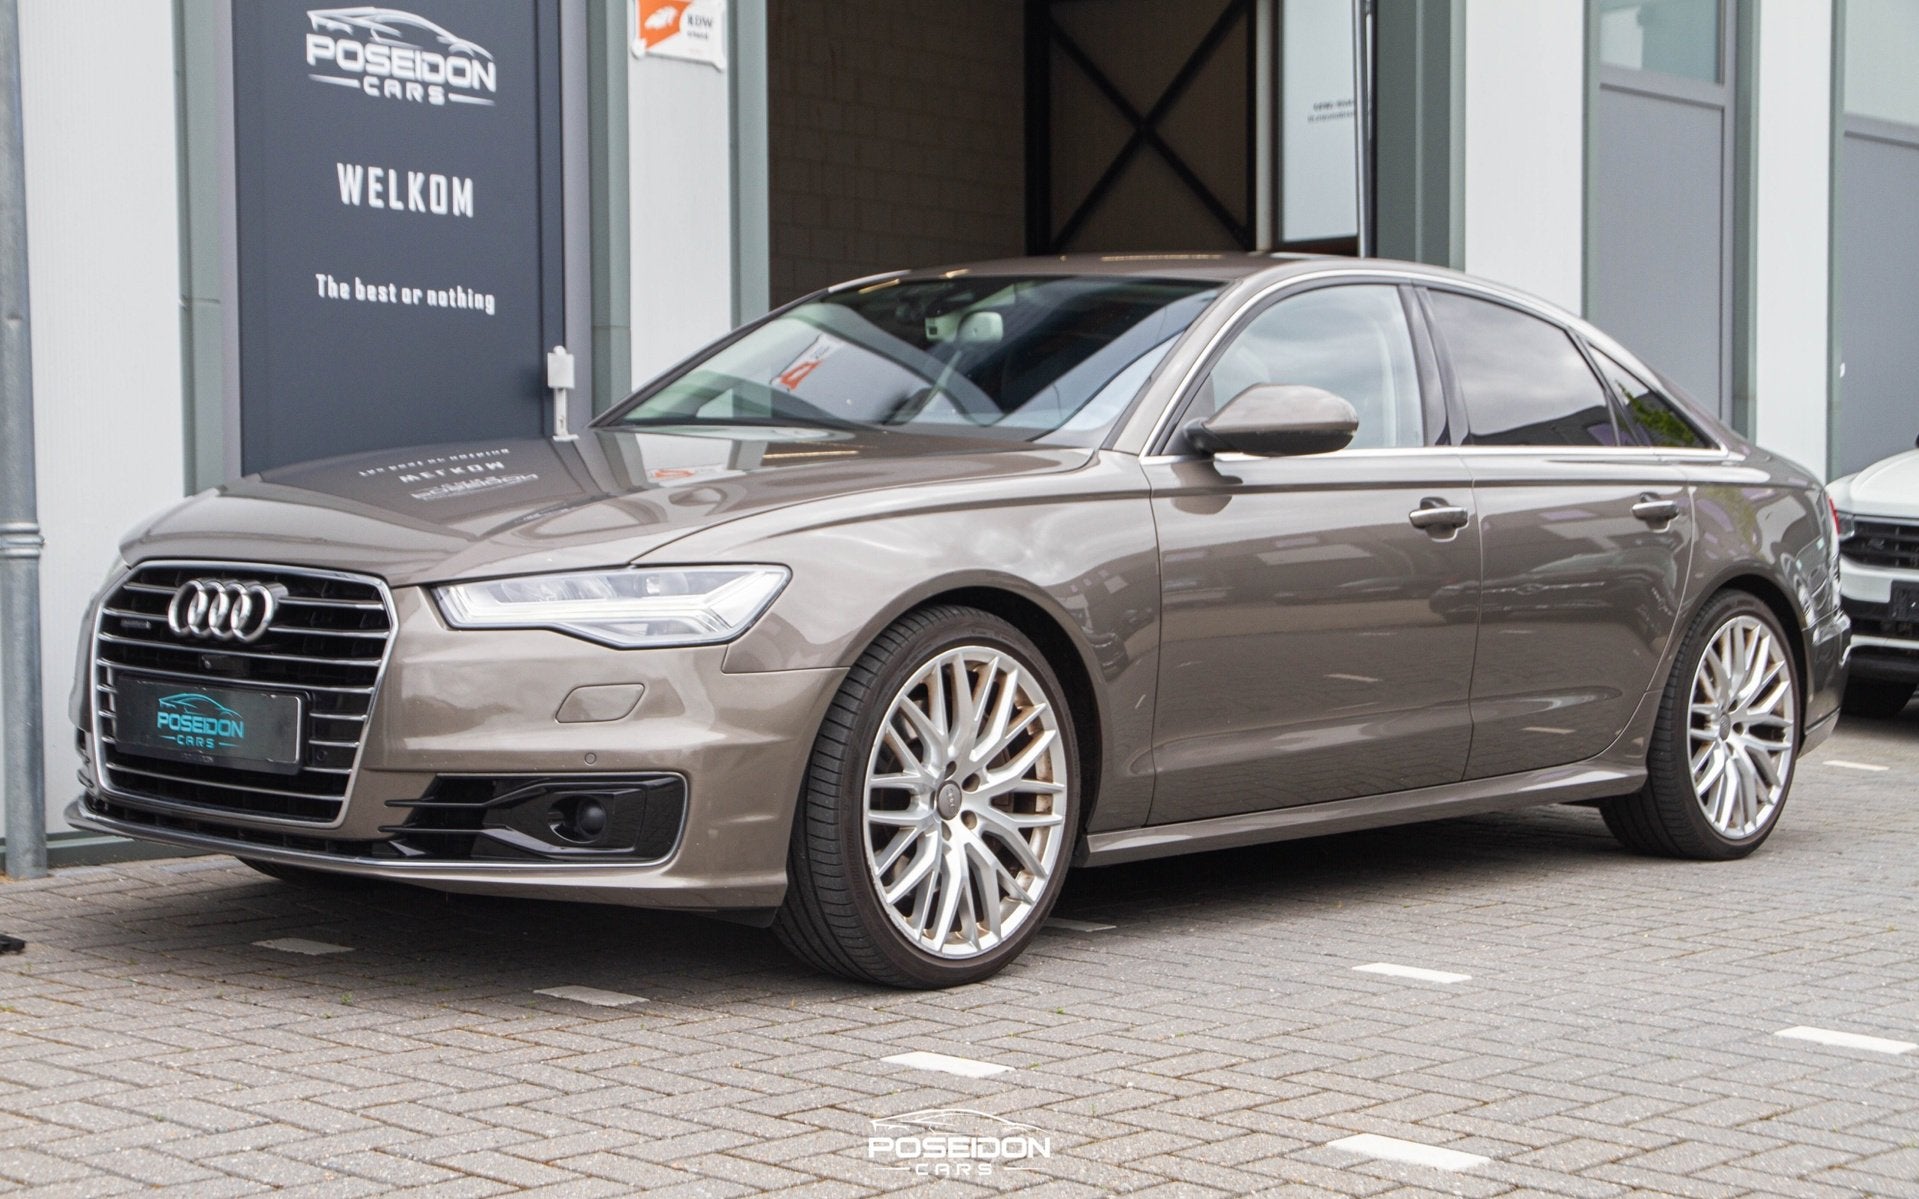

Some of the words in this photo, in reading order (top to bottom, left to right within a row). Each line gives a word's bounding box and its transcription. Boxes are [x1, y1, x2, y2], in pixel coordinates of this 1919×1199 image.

[306, 33, 496, 92] POSEIDON
[363, 75, 445, 105] CARS
[337, 162, 474, 218] WELKOM
[315, 273, 350, 300] The
[355, 276, 397, 303] best
[401, 287, 422, 305] or
[427, 285, 495, 315] nothing
[157, 711, 244, 738] POSEIDON
[176, 734, 215, 749] CARS
